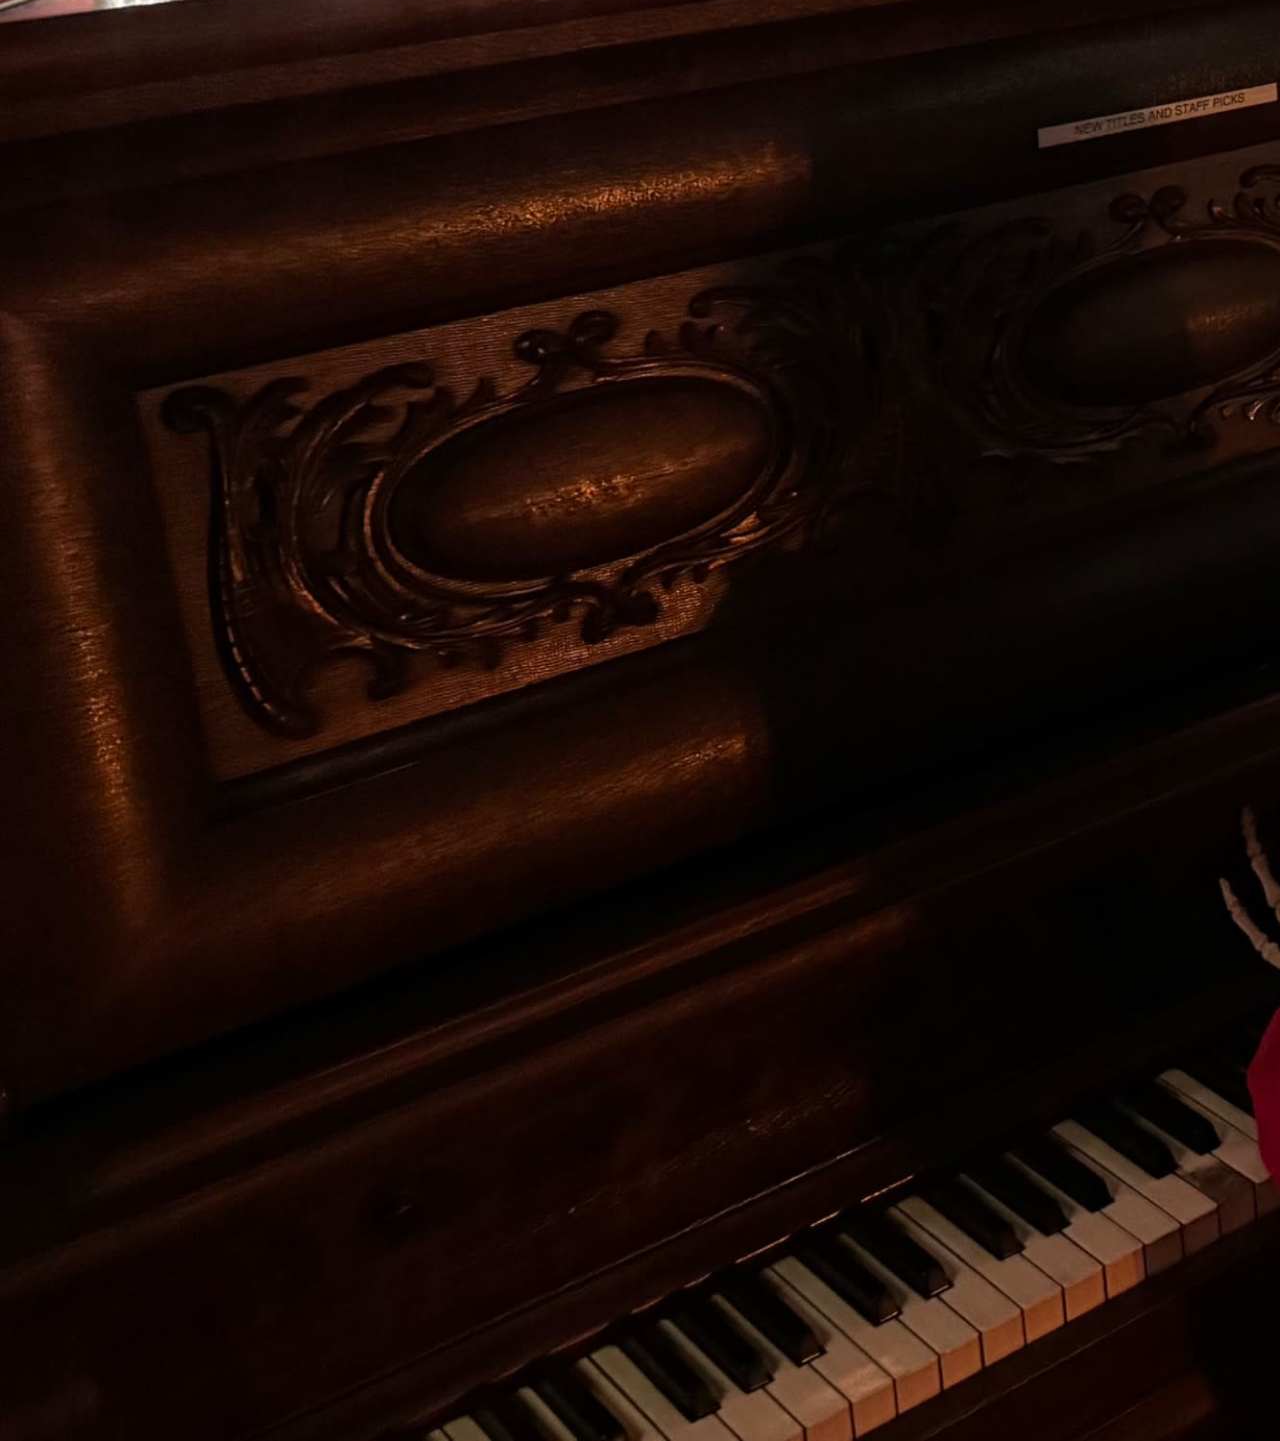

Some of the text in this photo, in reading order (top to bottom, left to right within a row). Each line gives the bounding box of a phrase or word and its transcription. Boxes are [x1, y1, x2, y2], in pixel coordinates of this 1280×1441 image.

[1073, 92, 1246, 136] NEW TITLES AND STAFF PICKS
